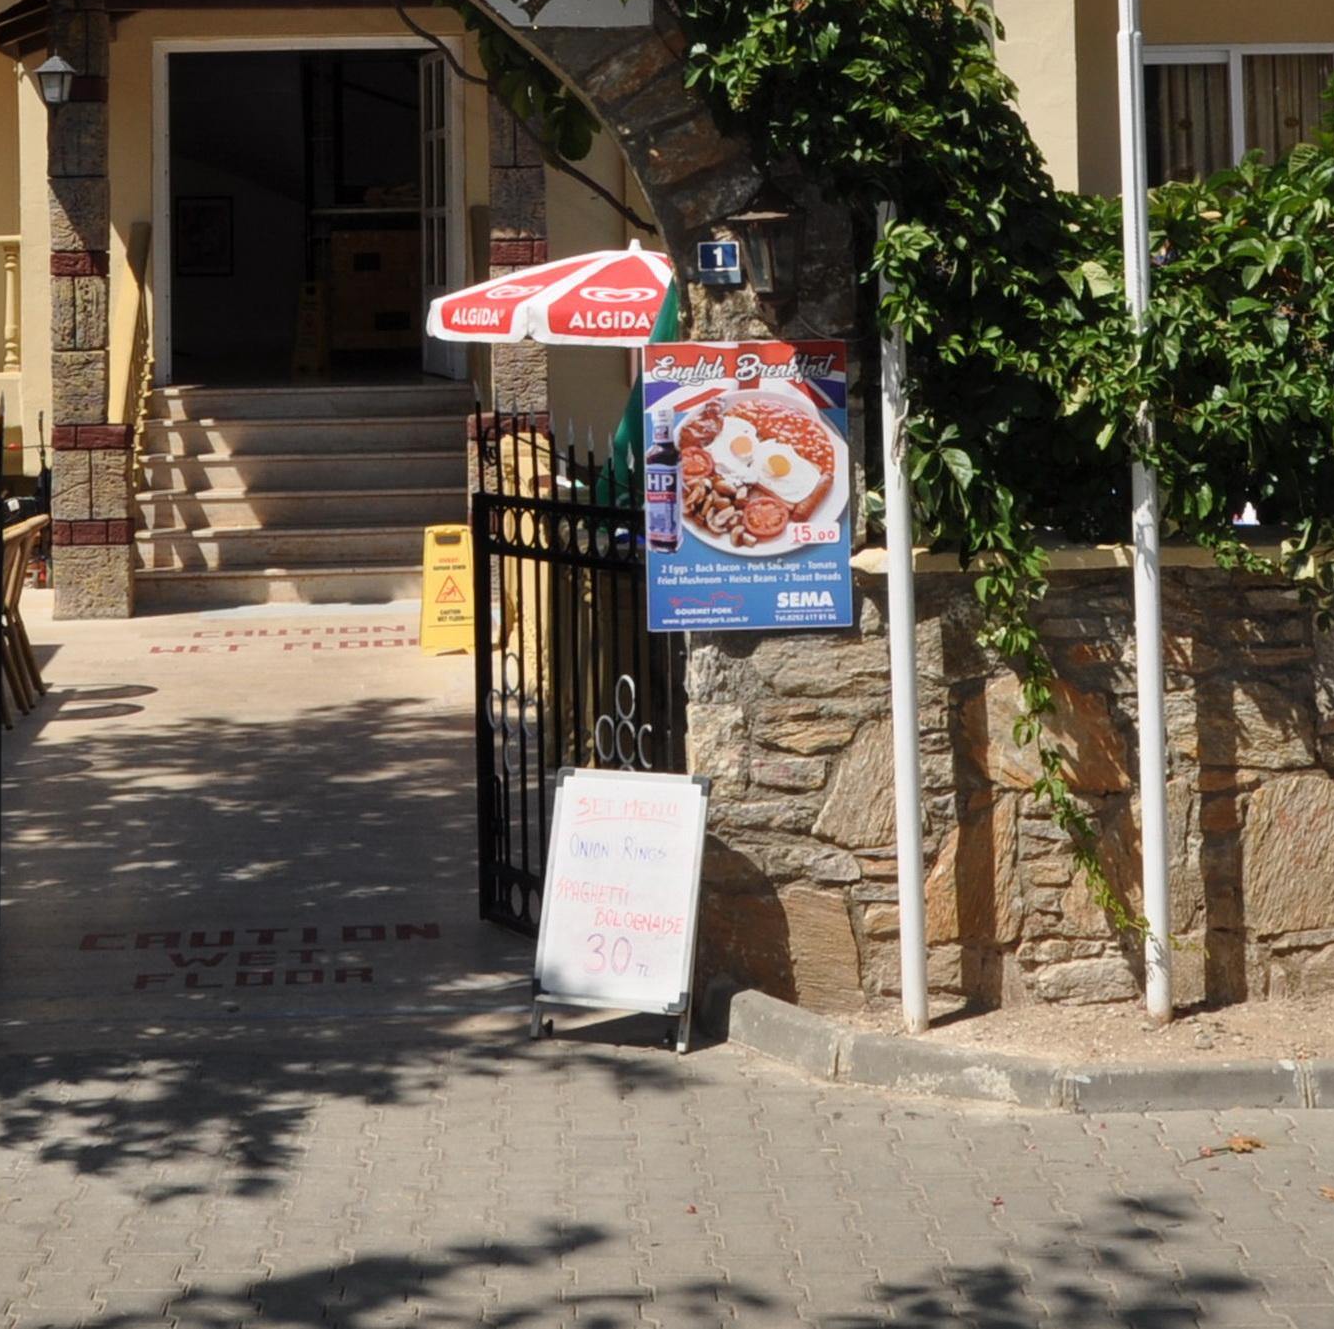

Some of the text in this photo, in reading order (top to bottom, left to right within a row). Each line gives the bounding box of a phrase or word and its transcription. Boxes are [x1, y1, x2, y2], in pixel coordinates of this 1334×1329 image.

[712, 246, 723, 267] 1
[651, 353, 836, 386] English Breakfast
[647, 473, 674, 492] HP
[669, 564, 688, 576] Eggs
[695, 562, 714, 573] Back
[716, 562, 740, 572] Bacon
[747, 561, 765, 571] Pork
[808, 560, 837, 570] Tomato
[657, 575, 678, 585] Fried
[679, 574, 722, 585] Mushroom
[753, 573, 777, 583] Beans
[777, 591, 834, 608] SEMA
[674, 607, 710, 616] GOURMET
[192, 625, 406, 639] CAUTION
[575, 797, 678, 818] SET MENU
[556, 877, 631, 904] SPAGHETTI
[78, 923, 442, 951] CAUTION
[168, 949, 327, 969] WET
[585, 933, 633, 976] 30
[133, 966, 375, 990] FLOOR
